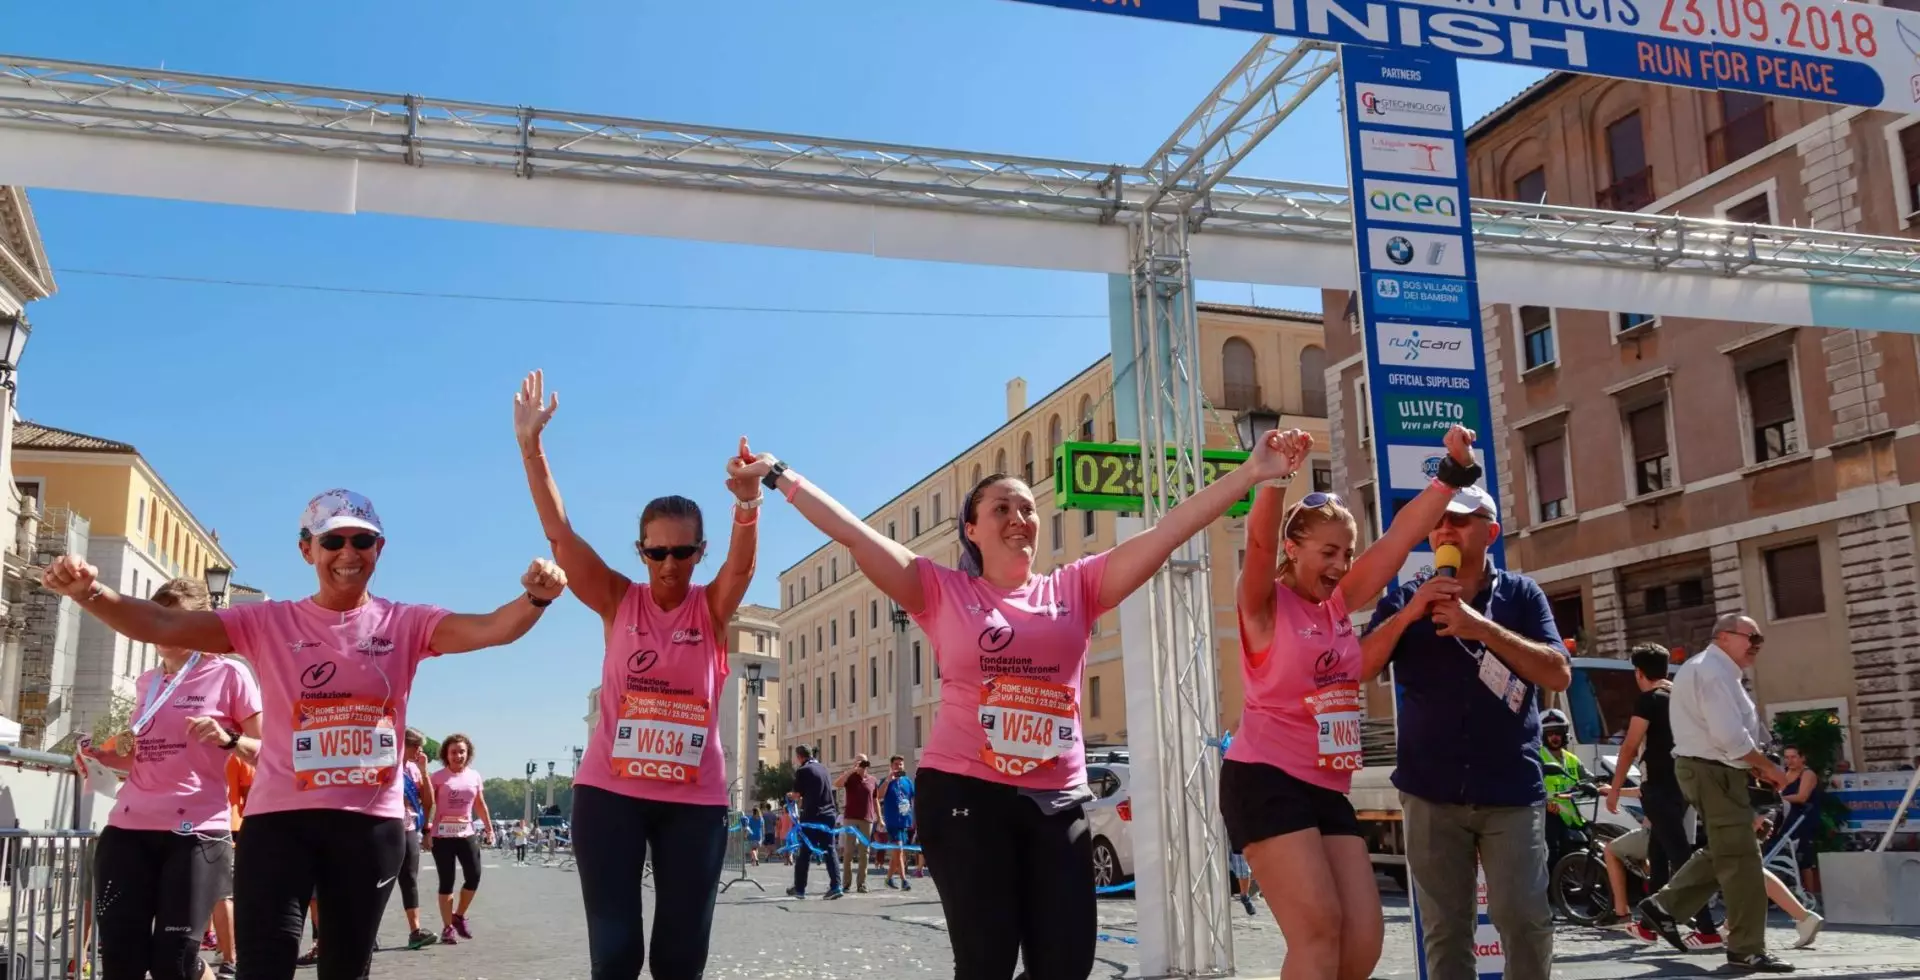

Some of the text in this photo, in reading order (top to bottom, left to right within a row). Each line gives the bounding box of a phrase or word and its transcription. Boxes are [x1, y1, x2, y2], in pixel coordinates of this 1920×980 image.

[1658, 0, 1877, 58] 23.09.2018
[1381, 66, 1422, 82] PARTNERS
[1637, 41, 1838, 95] RUN FOR PEACE
[1370, 190, 1456, 217] acea
[1402, 280, 1463, 293] SOS VILLAGGI
[1403, 291, 1459, 303] DEI BAMBINI
[1388, 373, 1470, 389] OFFICIAL SUPPLIERS
[1399, 400, 1464, 419] ULIVETO
[980, 656, 1032, 665] Fondazione
[980, 664, 1060, 674] Umberto Veronesi
[627, 675, 670, 687] Fondazione
[301, 691, 352, 699] Fondazione
[627, 683, 694, 696] Umberto Veronesi
[1001, 684, 1069, 701] ROME HALF MARATH
[639, 698, 657, 706] ROME
[673, 702, 706, 713] MARATHON
[1014, 695, 1035, 704] PACIS
[315, 703, 385, 715] ROME HALF MARATH
[649, 707, 668, 717] PACIS
[315, 715, 328, 723] VIA
[329, 712, 350, 721] PACIS
[1002, 711, 1053, 746] W548
[319, 729, 373, 757] W505
[637, 727, 684, 757] W636
[995, 756, 1038, 776] ace
[1332, 754, 1363, 770] ace
[314, 768, 379, 786] acea
[627, 761, 685, 781] acea
